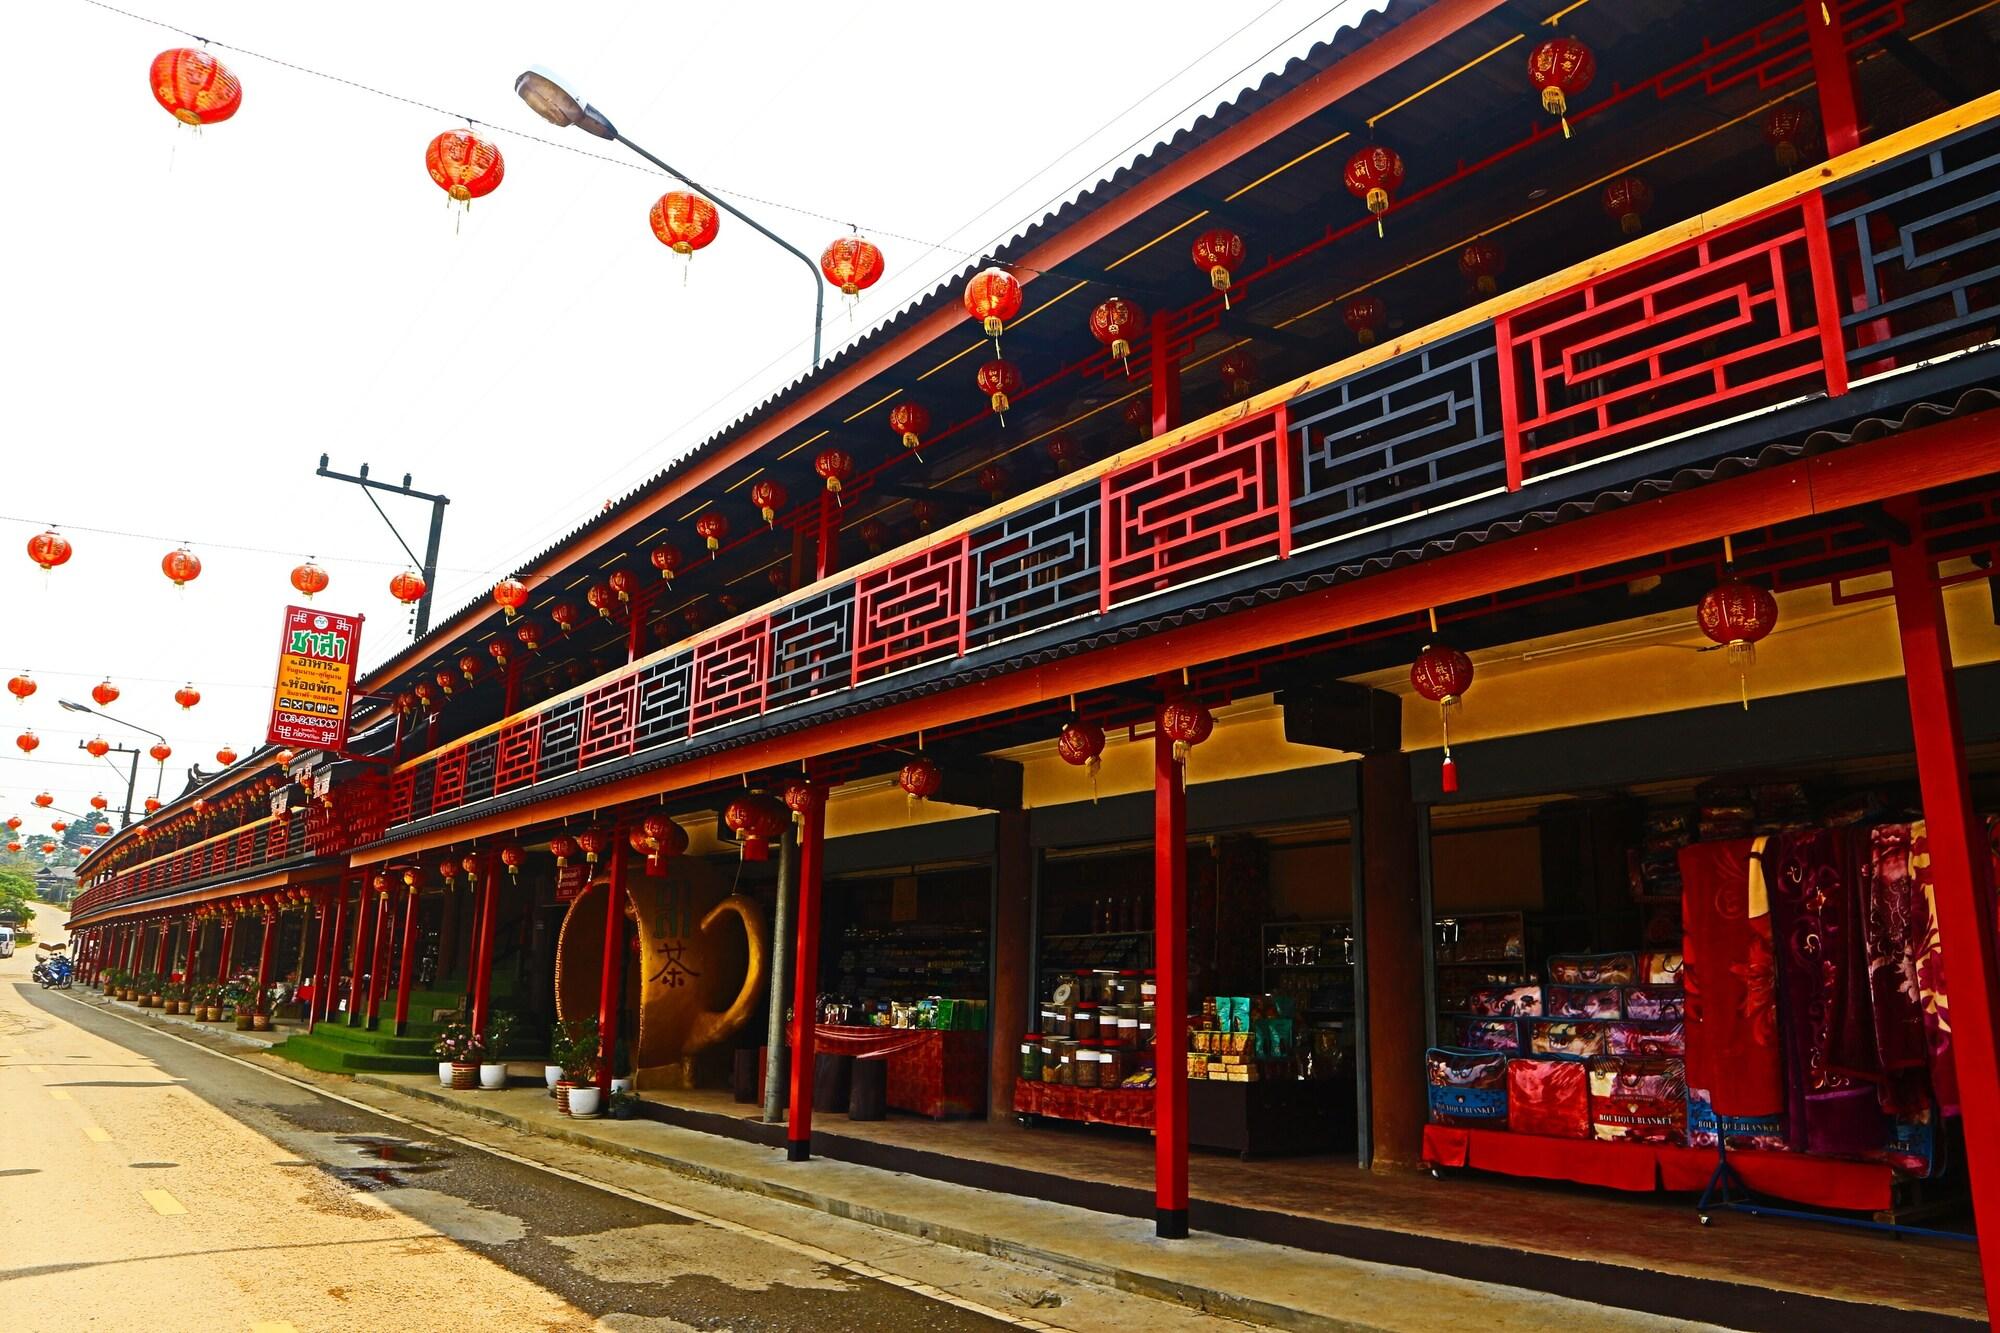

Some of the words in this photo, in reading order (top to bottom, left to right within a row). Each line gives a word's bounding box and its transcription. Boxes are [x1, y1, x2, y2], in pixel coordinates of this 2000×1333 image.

[299, 657, 334, 671] อาหาร
[288, 676, 335, 695] ห้องพัก
[649, 939, 701, 989] 茶
[1599, 1112, 1635, 1125] BOUTIQUE
[1636, 1115, 1672, 1126] BLANKET
[1698, 1119, 1740, 1131] BOUTQUE
